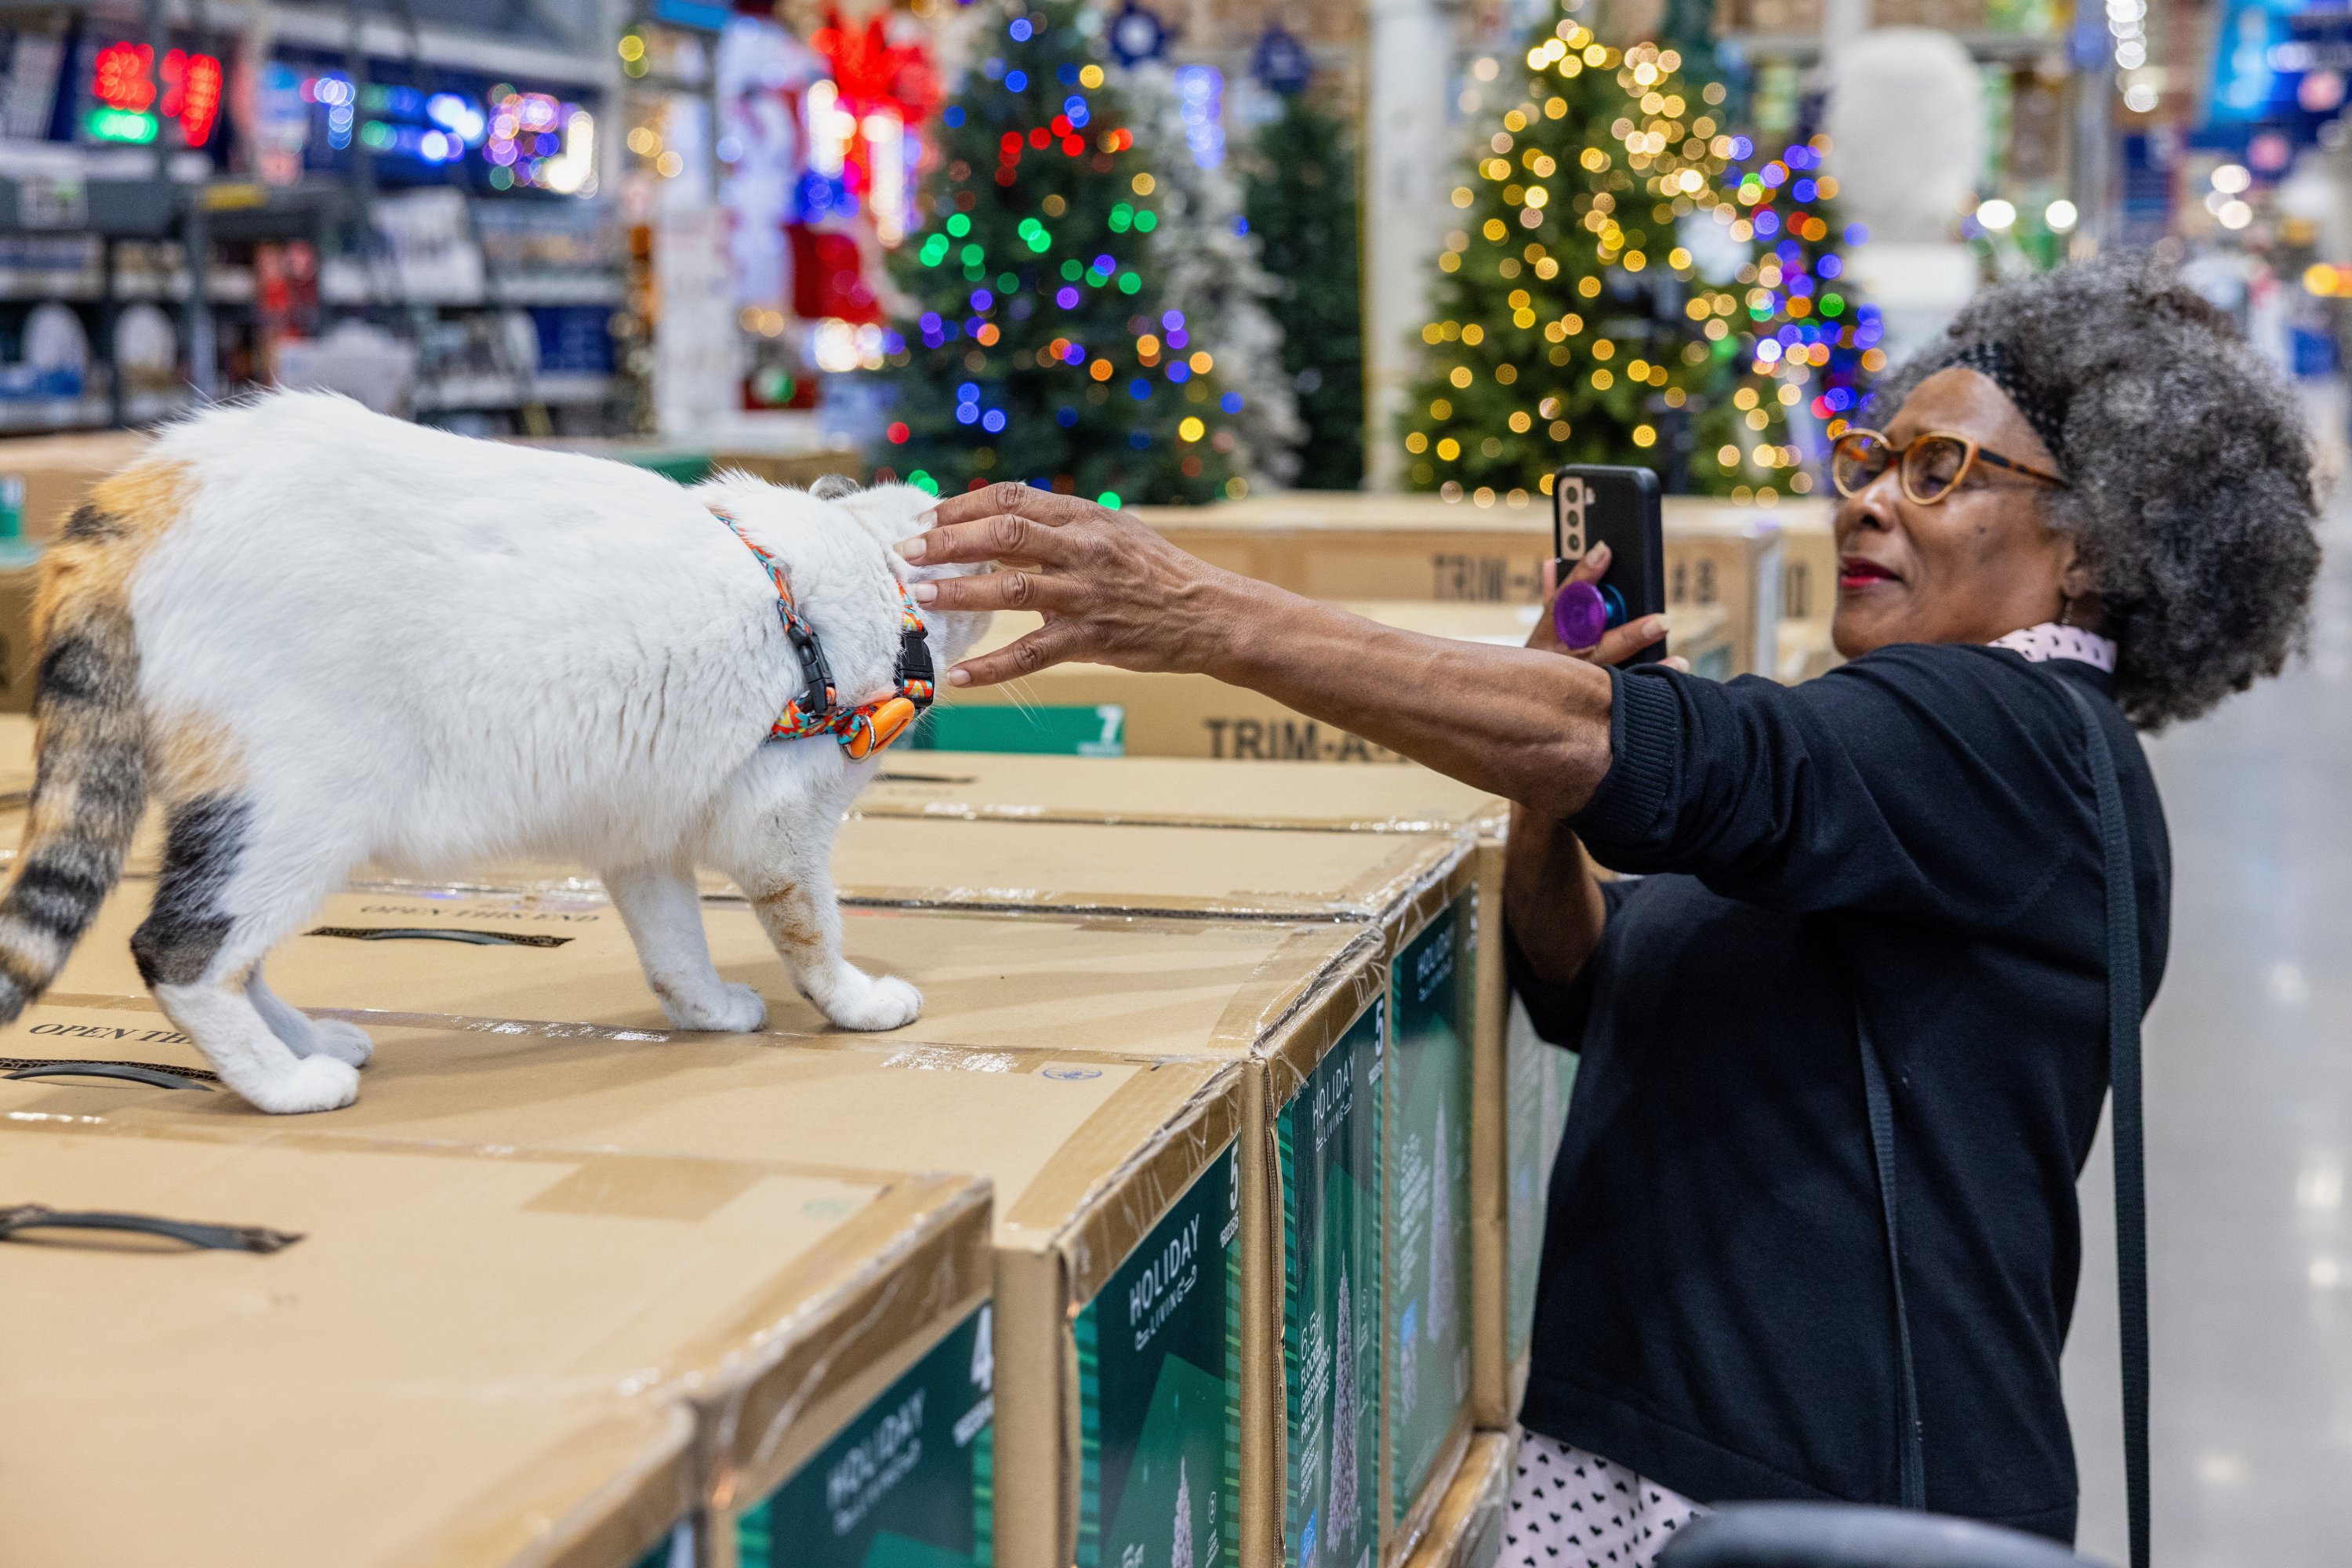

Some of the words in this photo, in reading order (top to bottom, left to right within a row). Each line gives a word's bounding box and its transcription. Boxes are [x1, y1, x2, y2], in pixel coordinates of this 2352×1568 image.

[29, 1024, 136, 1040] OPEN
[1312, 1051, 1355, 1131] HOLIDAY
[1323, 1107, 1343, 1142] LIVING
[1229, 1141, 1239, 1211] 5
[1130, 1213, 1200, 1326] HOLIDAY
[1149, 1284, 1185, 1335] LIVING
[1301, 1336, 1322, 1390] FLOCKED
